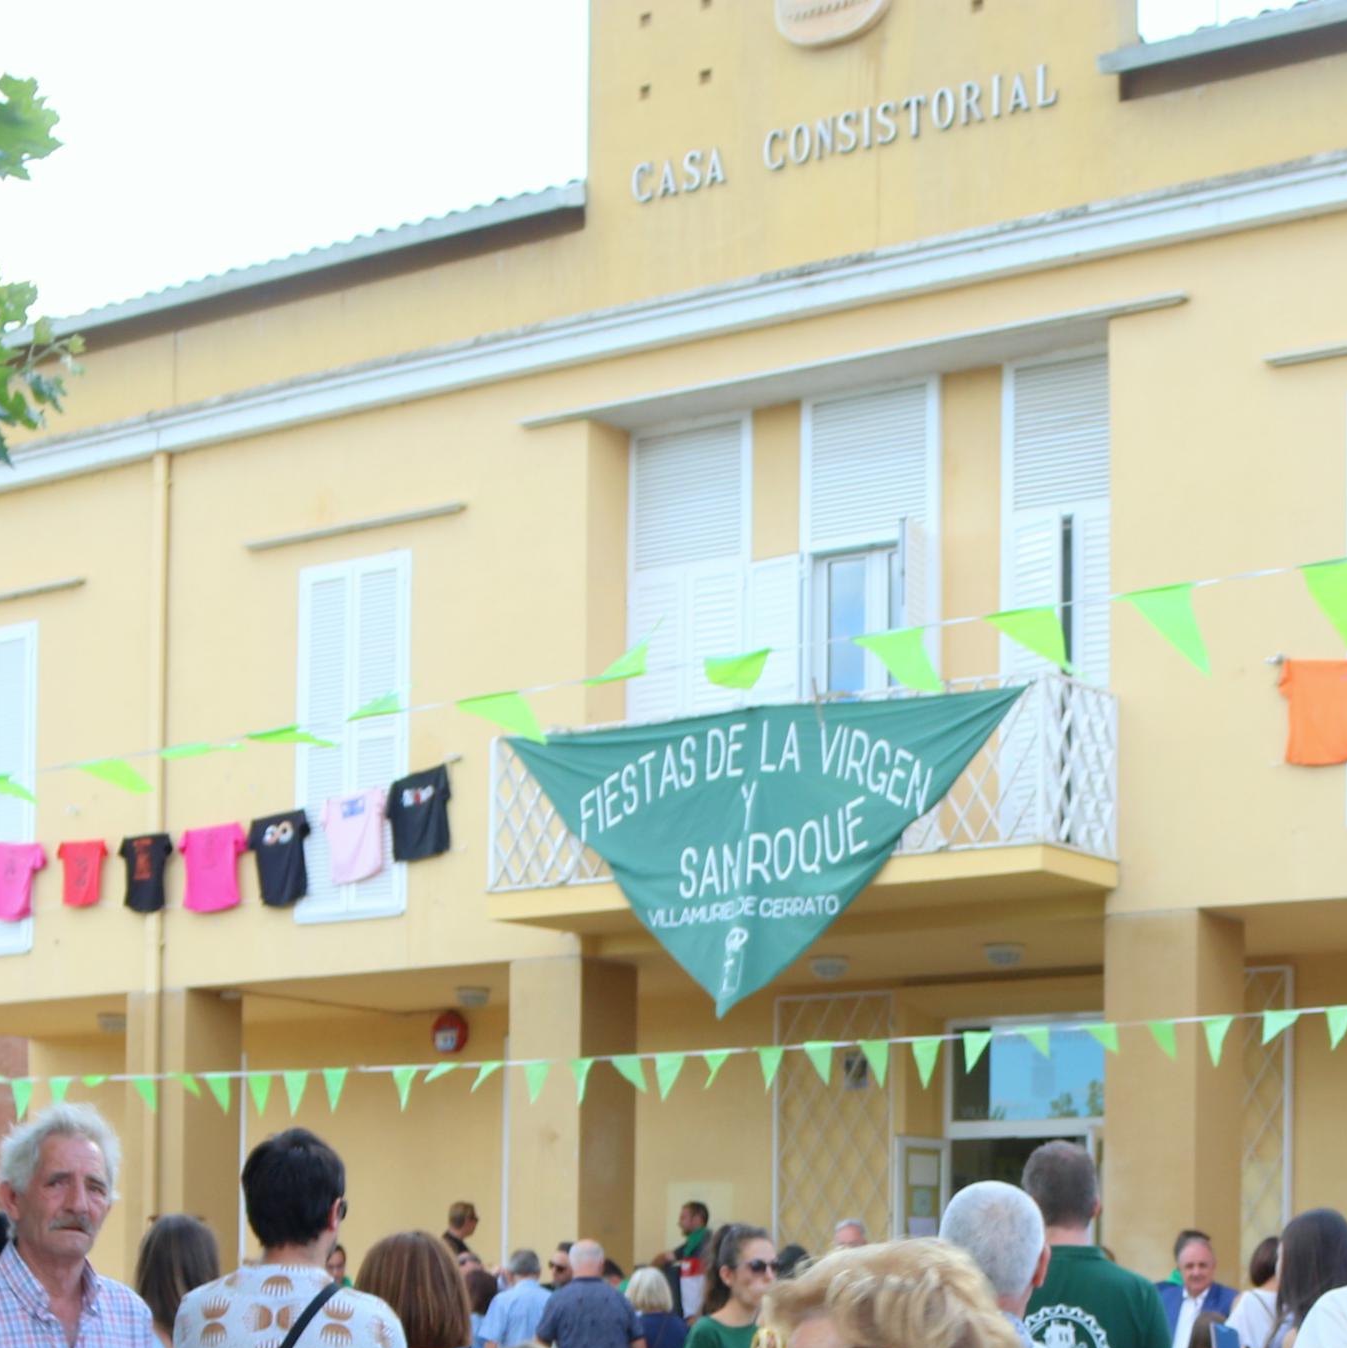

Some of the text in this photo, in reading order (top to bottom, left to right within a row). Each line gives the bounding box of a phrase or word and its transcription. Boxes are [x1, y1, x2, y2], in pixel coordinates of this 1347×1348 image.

[631, 64, 1058, 203] CASA CONSISTORIAL
[580, 720, 933, 841] FIESTAS DE LA VIRGEN
[741, 781, 756, 831] Y
[679, 796, 868, 898] SAN ROQUE
[759, 894, 840, 918] CERRATO
